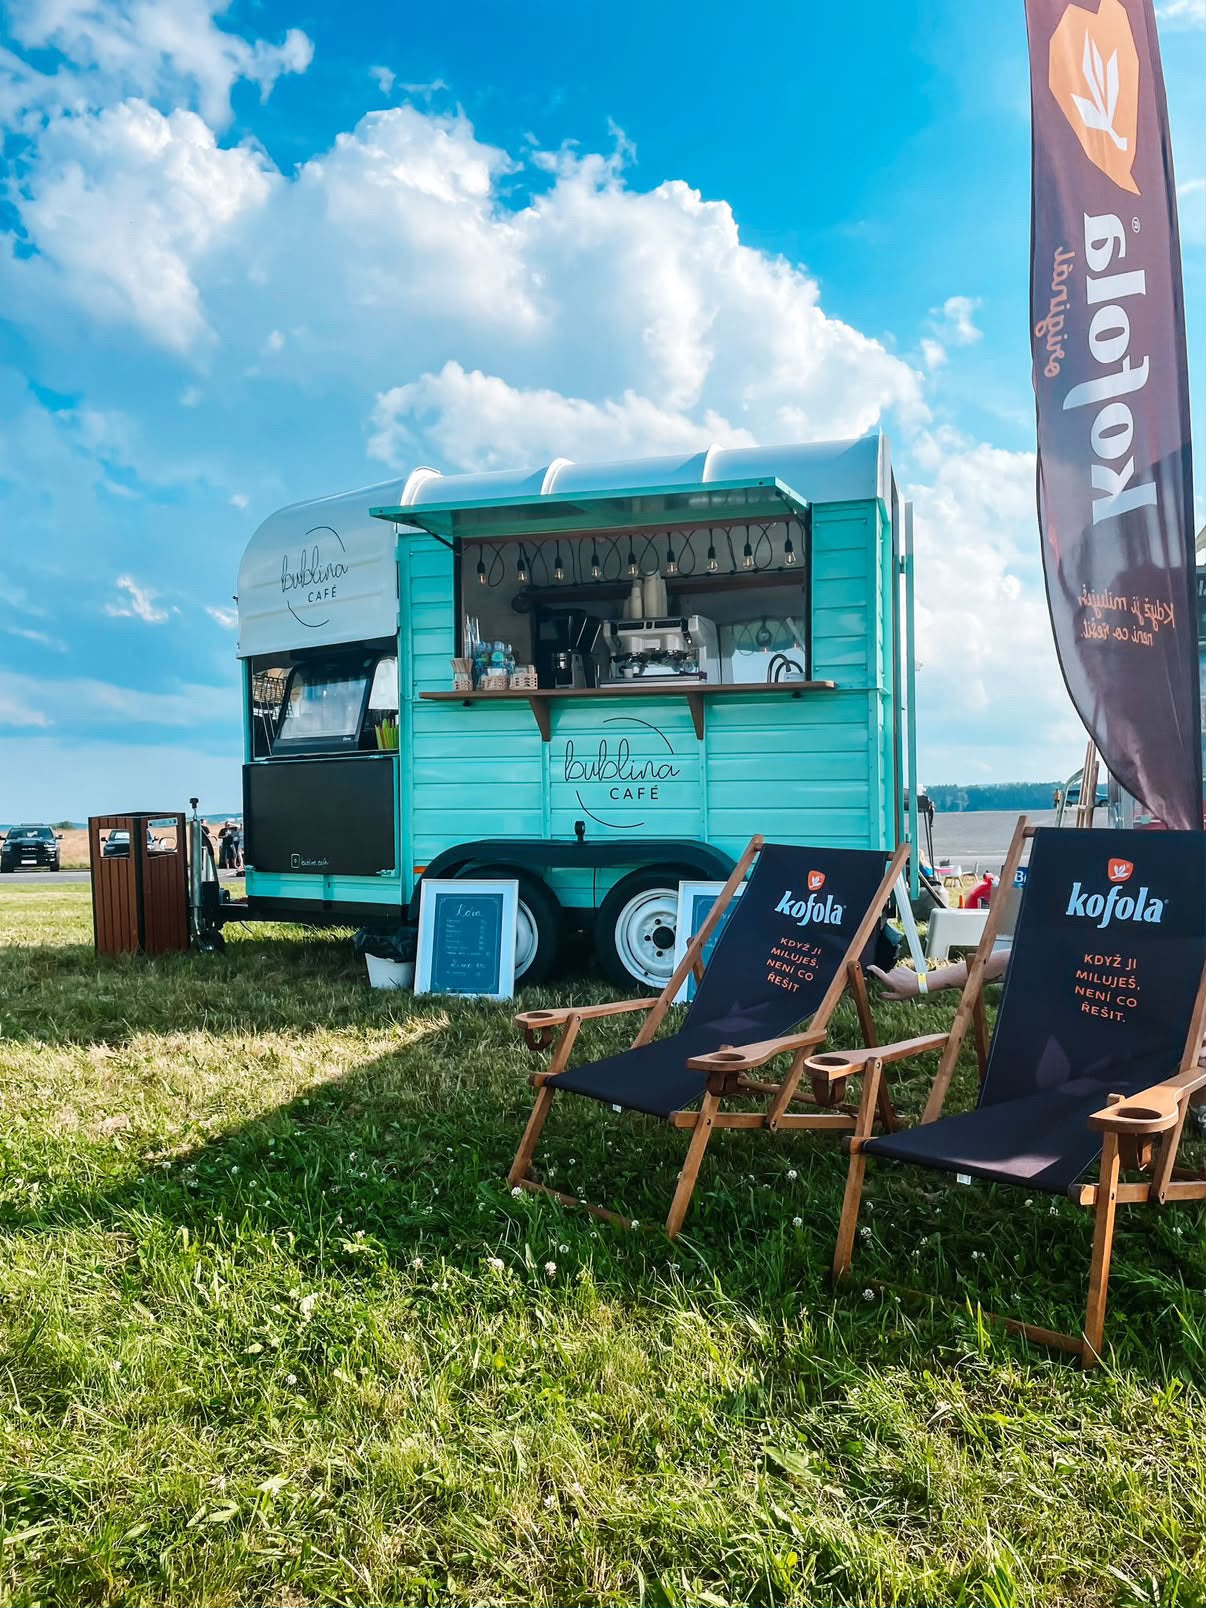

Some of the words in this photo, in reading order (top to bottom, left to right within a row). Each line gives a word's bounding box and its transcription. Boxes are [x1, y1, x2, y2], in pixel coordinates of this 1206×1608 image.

[281, 545, 349, 593] bublina
[308, 584, 337, 603] CAFÉ
[564, 738, 681, 782] bublina
[609, 784, 659, 800] CAFÉ
[774, 890, 843, 926] kofola
[1065, 882, 1164, 929] kofola
[780, 937, 811, 952] KDYŽ
[811, 947, 821, 955] JI
[766, 958, 795, 974] NENÍ
[797, 969, 814, 981] CO
[1084, 953, 1122, 968] KDYŽ
[1125, 958, 1137, 971] JI
[1076, 969, 1140, 991] MILUJEŠ,
[1074, 985, 1111, 1002] NENÍ
[1116, 996, 1137, 1008] CO
[1081, 1001, 1126, 1023] ŘEŠIT.
